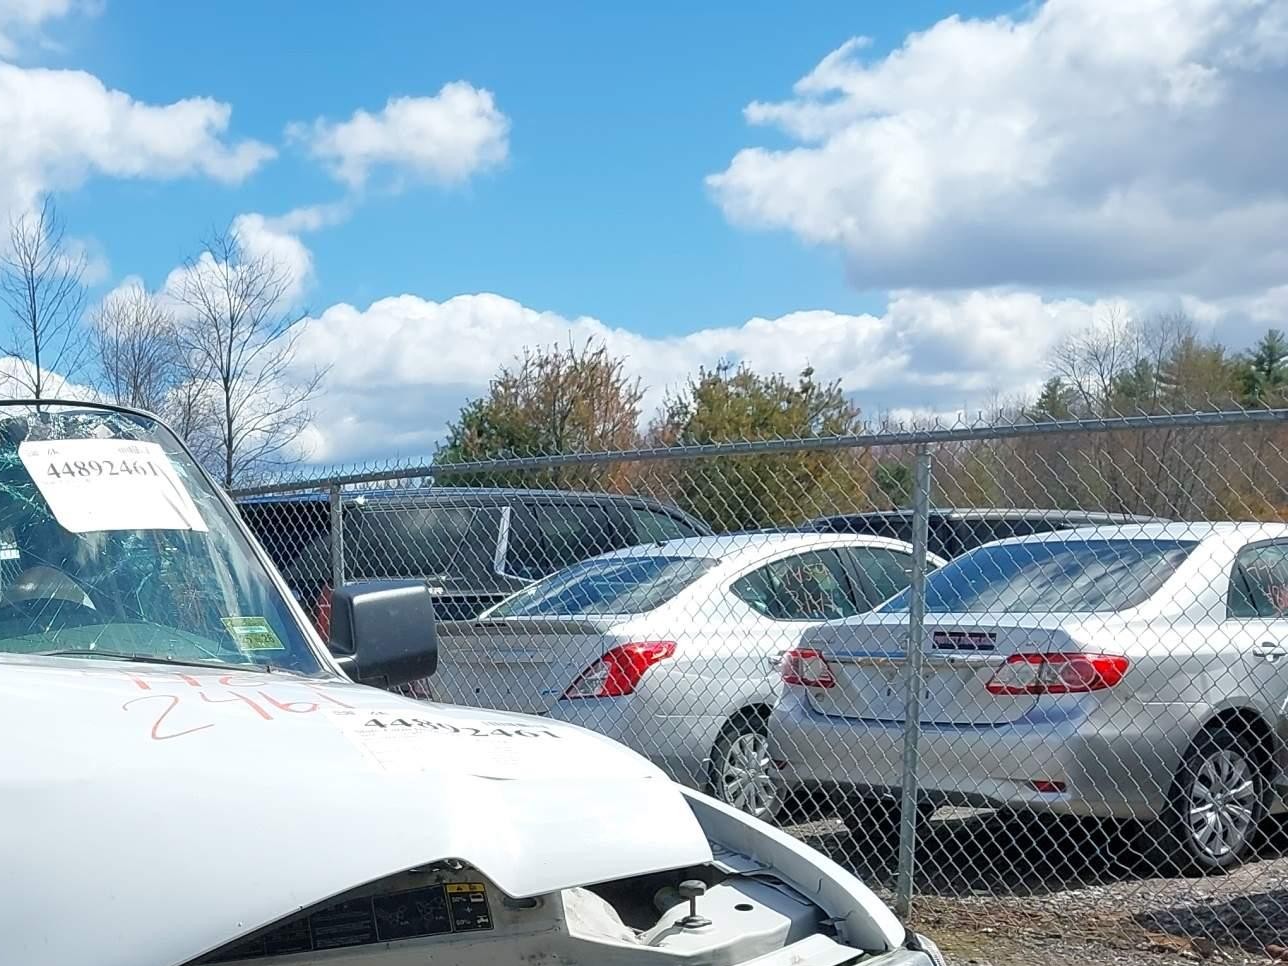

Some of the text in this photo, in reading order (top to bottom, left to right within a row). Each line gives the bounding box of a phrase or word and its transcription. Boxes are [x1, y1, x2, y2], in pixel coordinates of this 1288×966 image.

[47, 459, 159, 478] 44892461
[122, 691, 356, 740] 2461
[364, 718, 561, 739] 44892461
